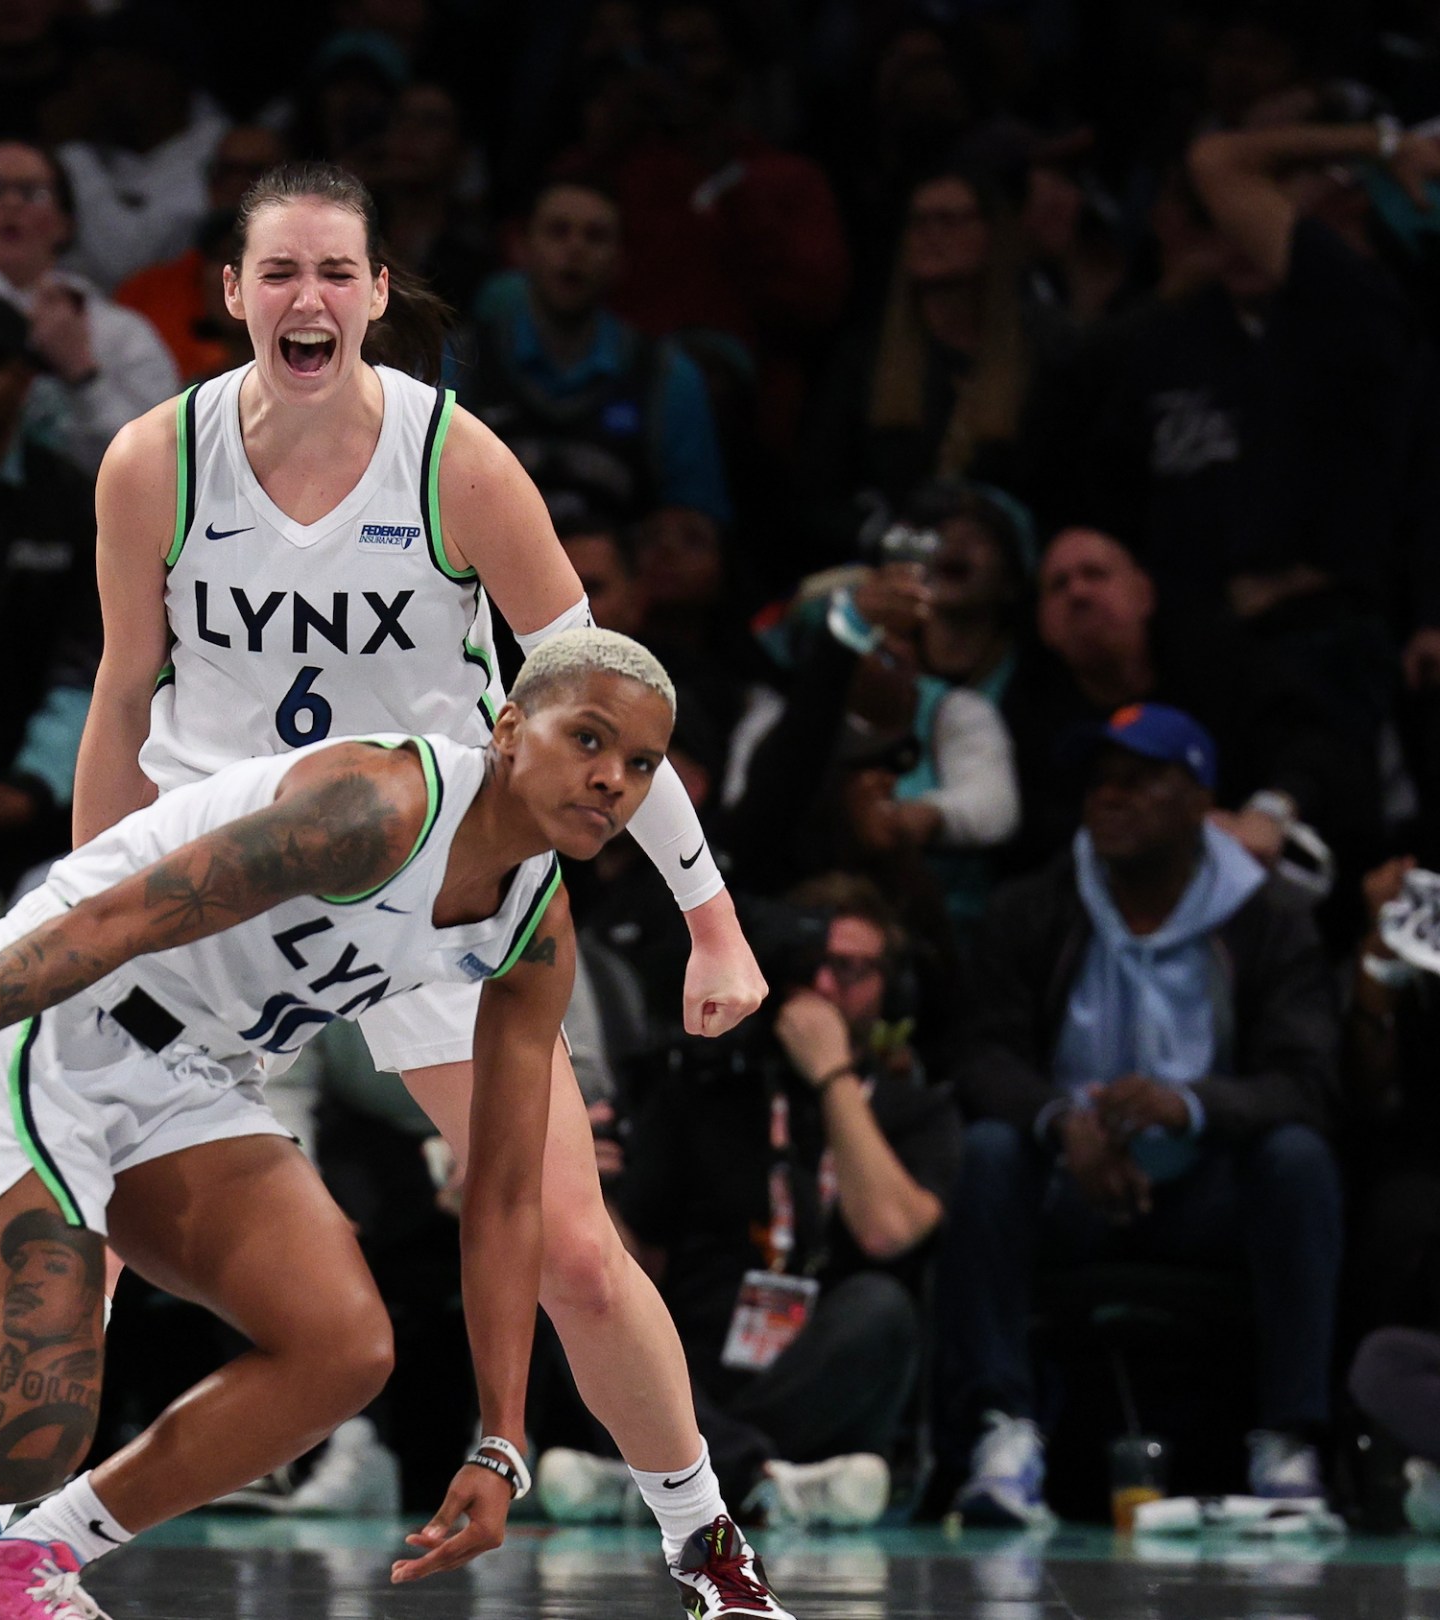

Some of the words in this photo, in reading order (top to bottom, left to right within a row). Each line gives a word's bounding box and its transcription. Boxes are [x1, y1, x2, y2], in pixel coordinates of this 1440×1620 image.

[361, 524, 421, 538] FEDERATED
[195, 580, 416, 655] LYNX
[275, 666, 332, 748] 6
[272, 915, 423, 1015] LYN
